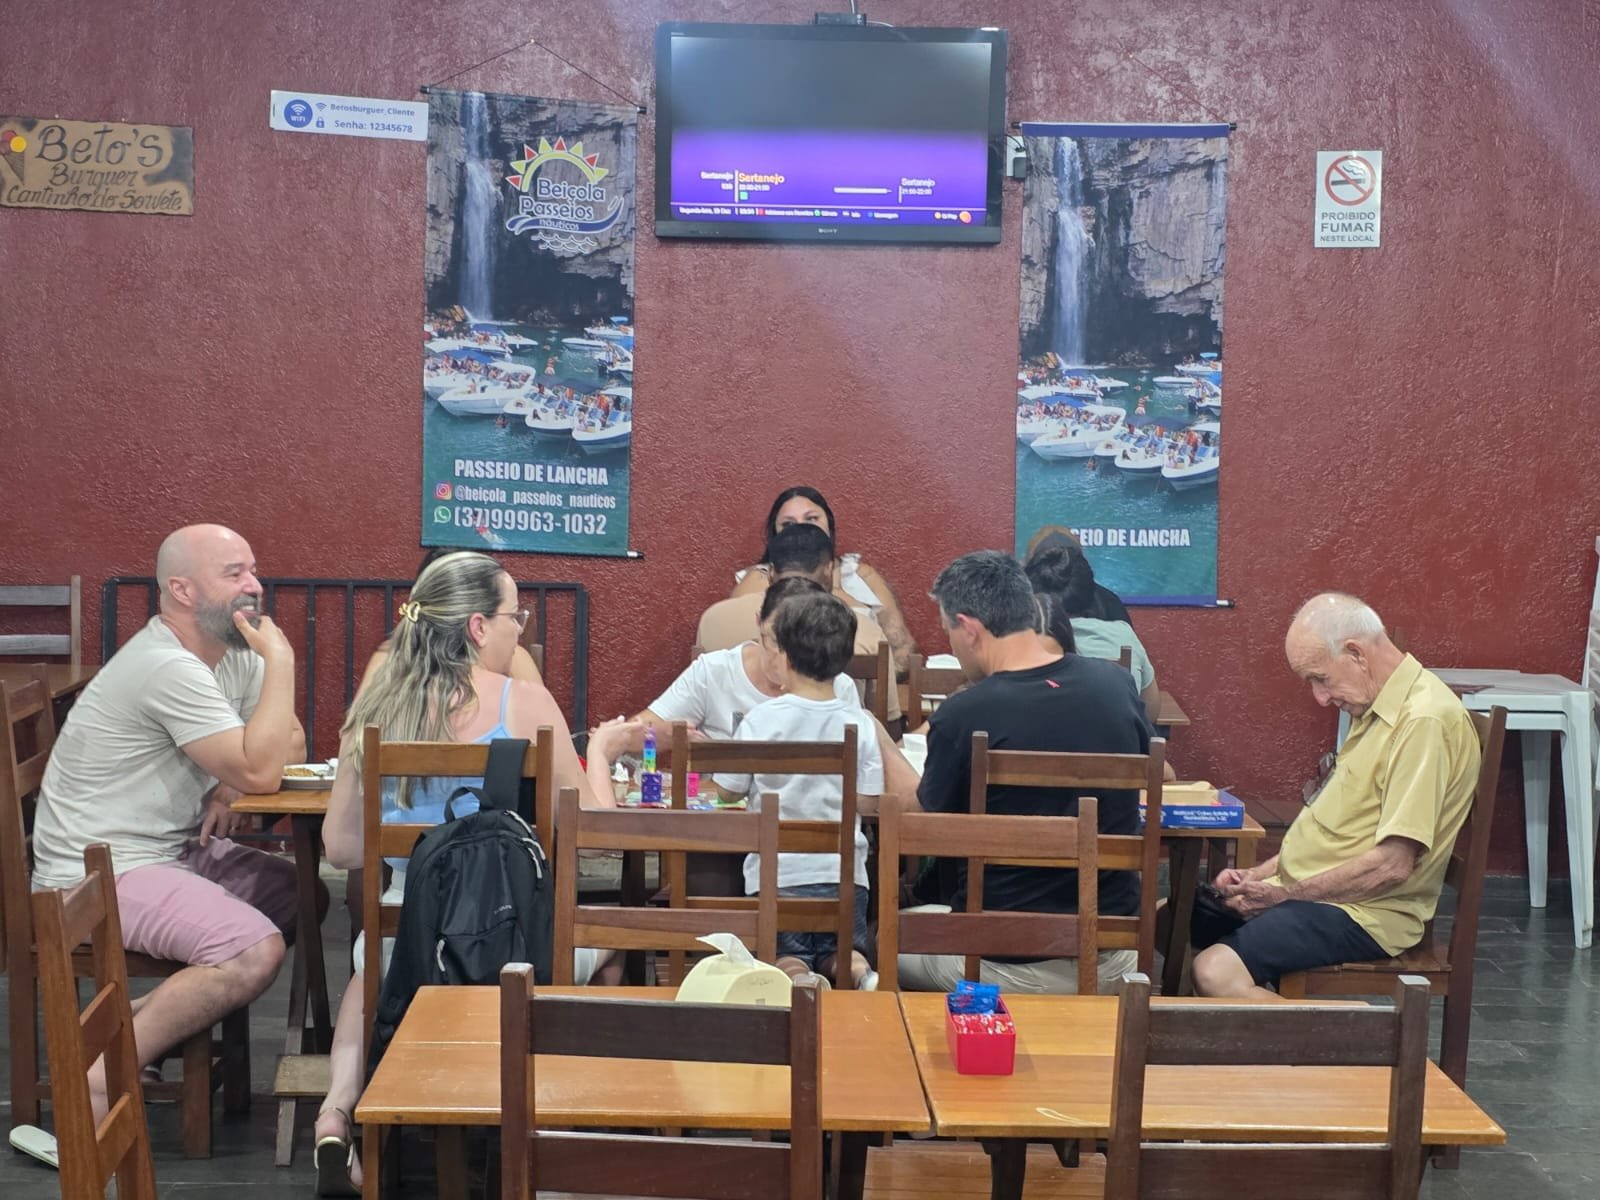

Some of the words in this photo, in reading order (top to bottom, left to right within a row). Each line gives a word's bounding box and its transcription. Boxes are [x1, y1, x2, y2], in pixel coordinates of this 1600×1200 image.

[334, 119, 366, 131] Senha:
[370, 122, 413, 134] 12345678
[49, 162, 138, 189] Burguer
[739, 172, 785, 185] Sertanejo
[7, 185, 91, 206] Cantinho
[119, 188, 183, 210] Sorvete
[537, 178, 606, 202] Beiçola
[519, 195, 594, 219] Passeios
[1321, 211, 1376, 221] PROIBIDO
[1320, 222, 1375, 233] FUMAR
[1320, 234, 1346, 242] NESTE
[1348, 234, 1375, 242] LOCAL
[454, 459, 520, 481] PASSEIO
[524, 463, 544, 483] DE
[547, 465, 609, 486] LANCHA
[454, 506, 607, 535] (37)99963-1032
[1107, 528, 1126, 546] DE
[1130, 528, 1190, 547] LANCHA
